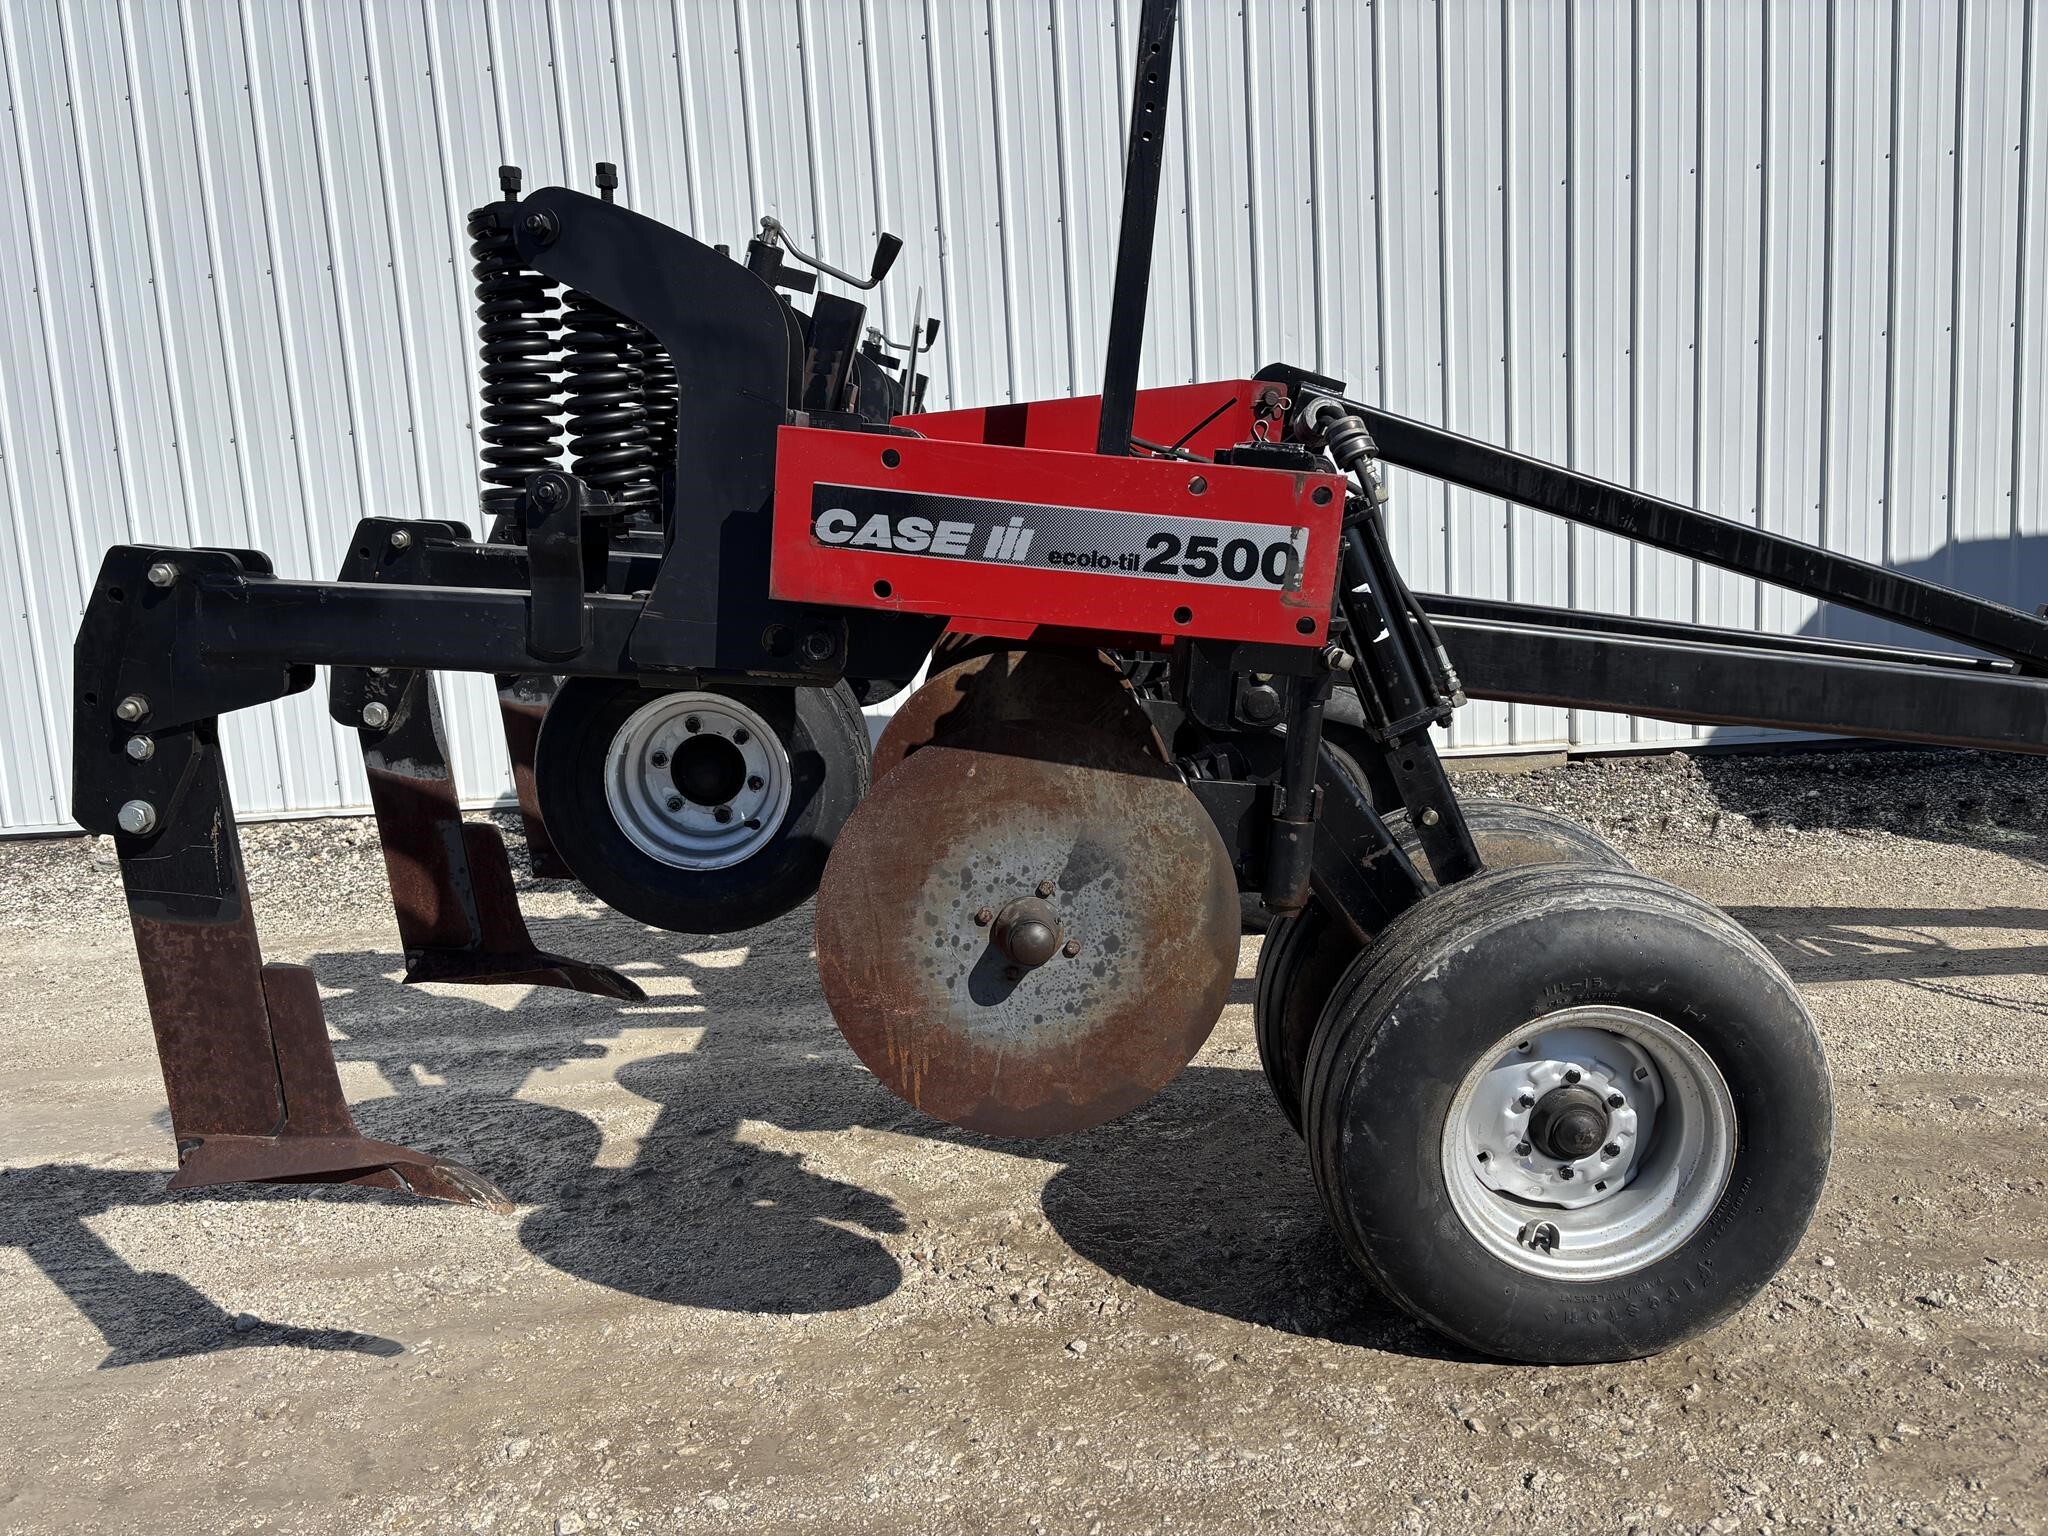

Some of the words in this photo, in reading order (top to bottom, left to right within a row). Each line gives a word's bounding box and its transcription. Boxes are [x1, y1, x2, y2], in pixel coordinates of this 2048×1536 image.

[815, 508, 976, 555] CASE
[1048, 550, 1140, 572] ecolo-til
[1143, 532, 1299, 584] 2500
